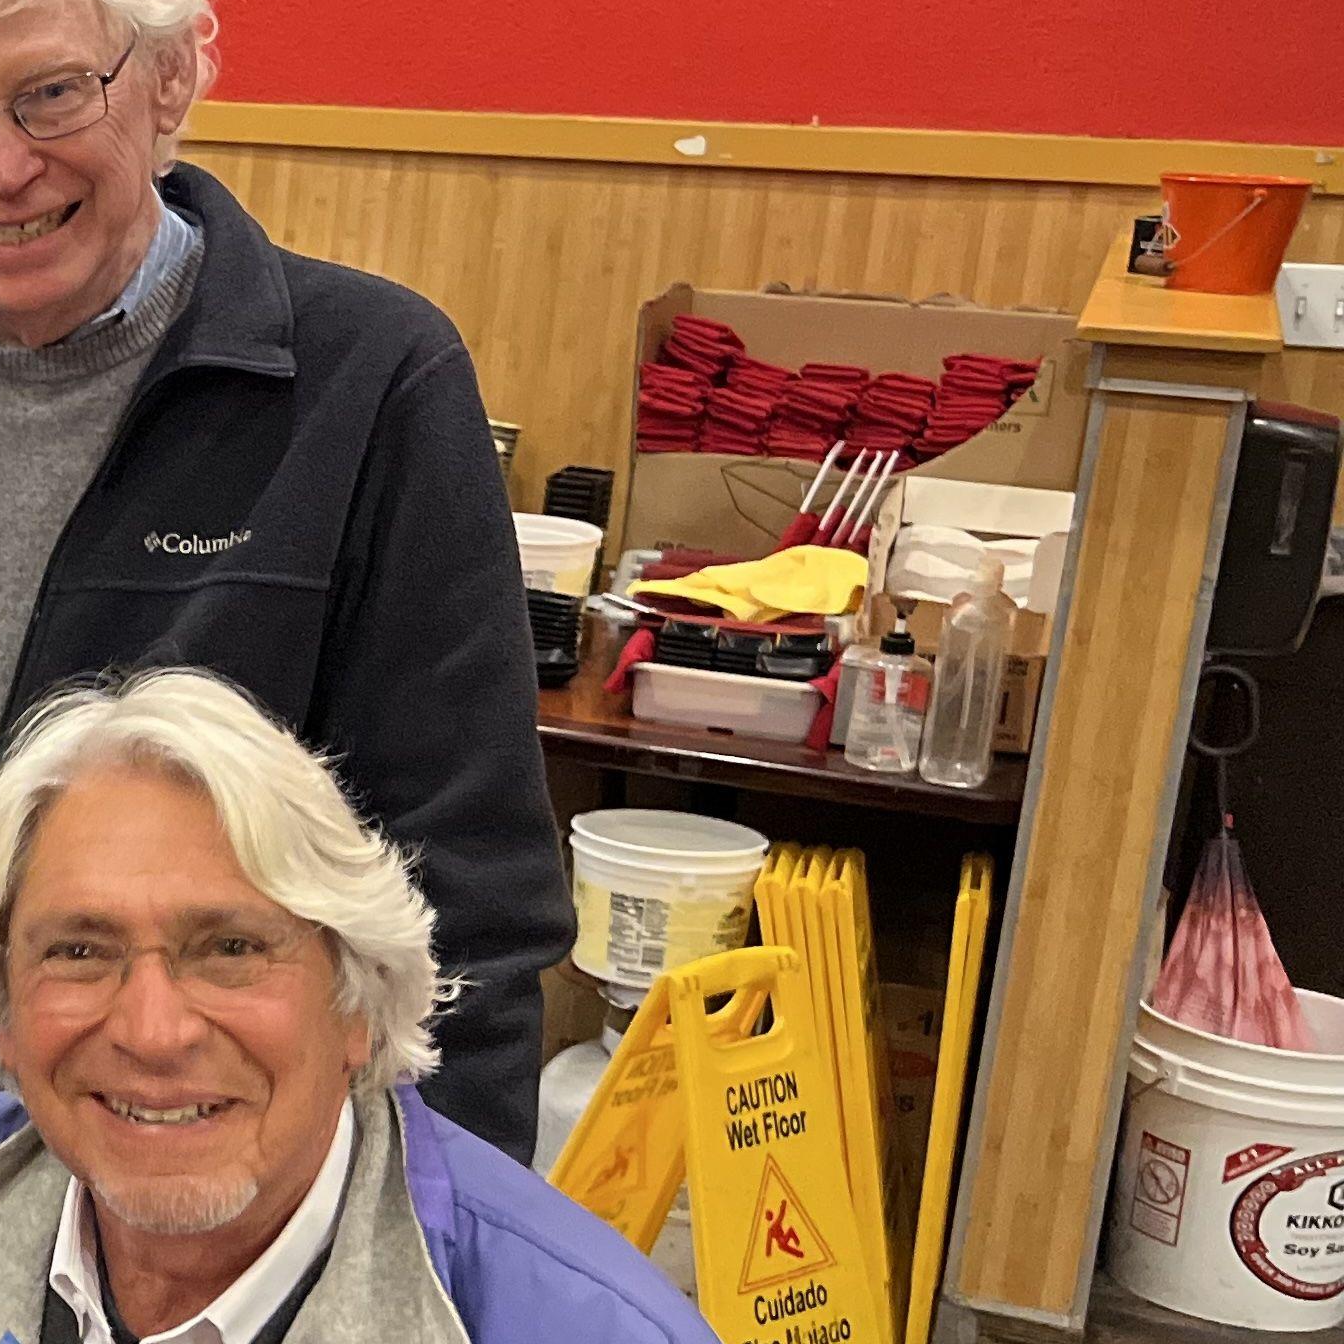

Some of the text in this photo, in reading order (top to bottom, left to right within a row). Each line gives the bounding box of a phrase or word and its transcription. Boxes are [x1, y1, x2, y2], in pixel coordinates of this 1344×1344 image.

[726, 1071, 799, 1116] CAUTION
[725, 1110, 807, 1151] Wet Floor
[1284, 1244, 1320, 1258] Soy
[754, 1278, 828, 1326] Cuidado
